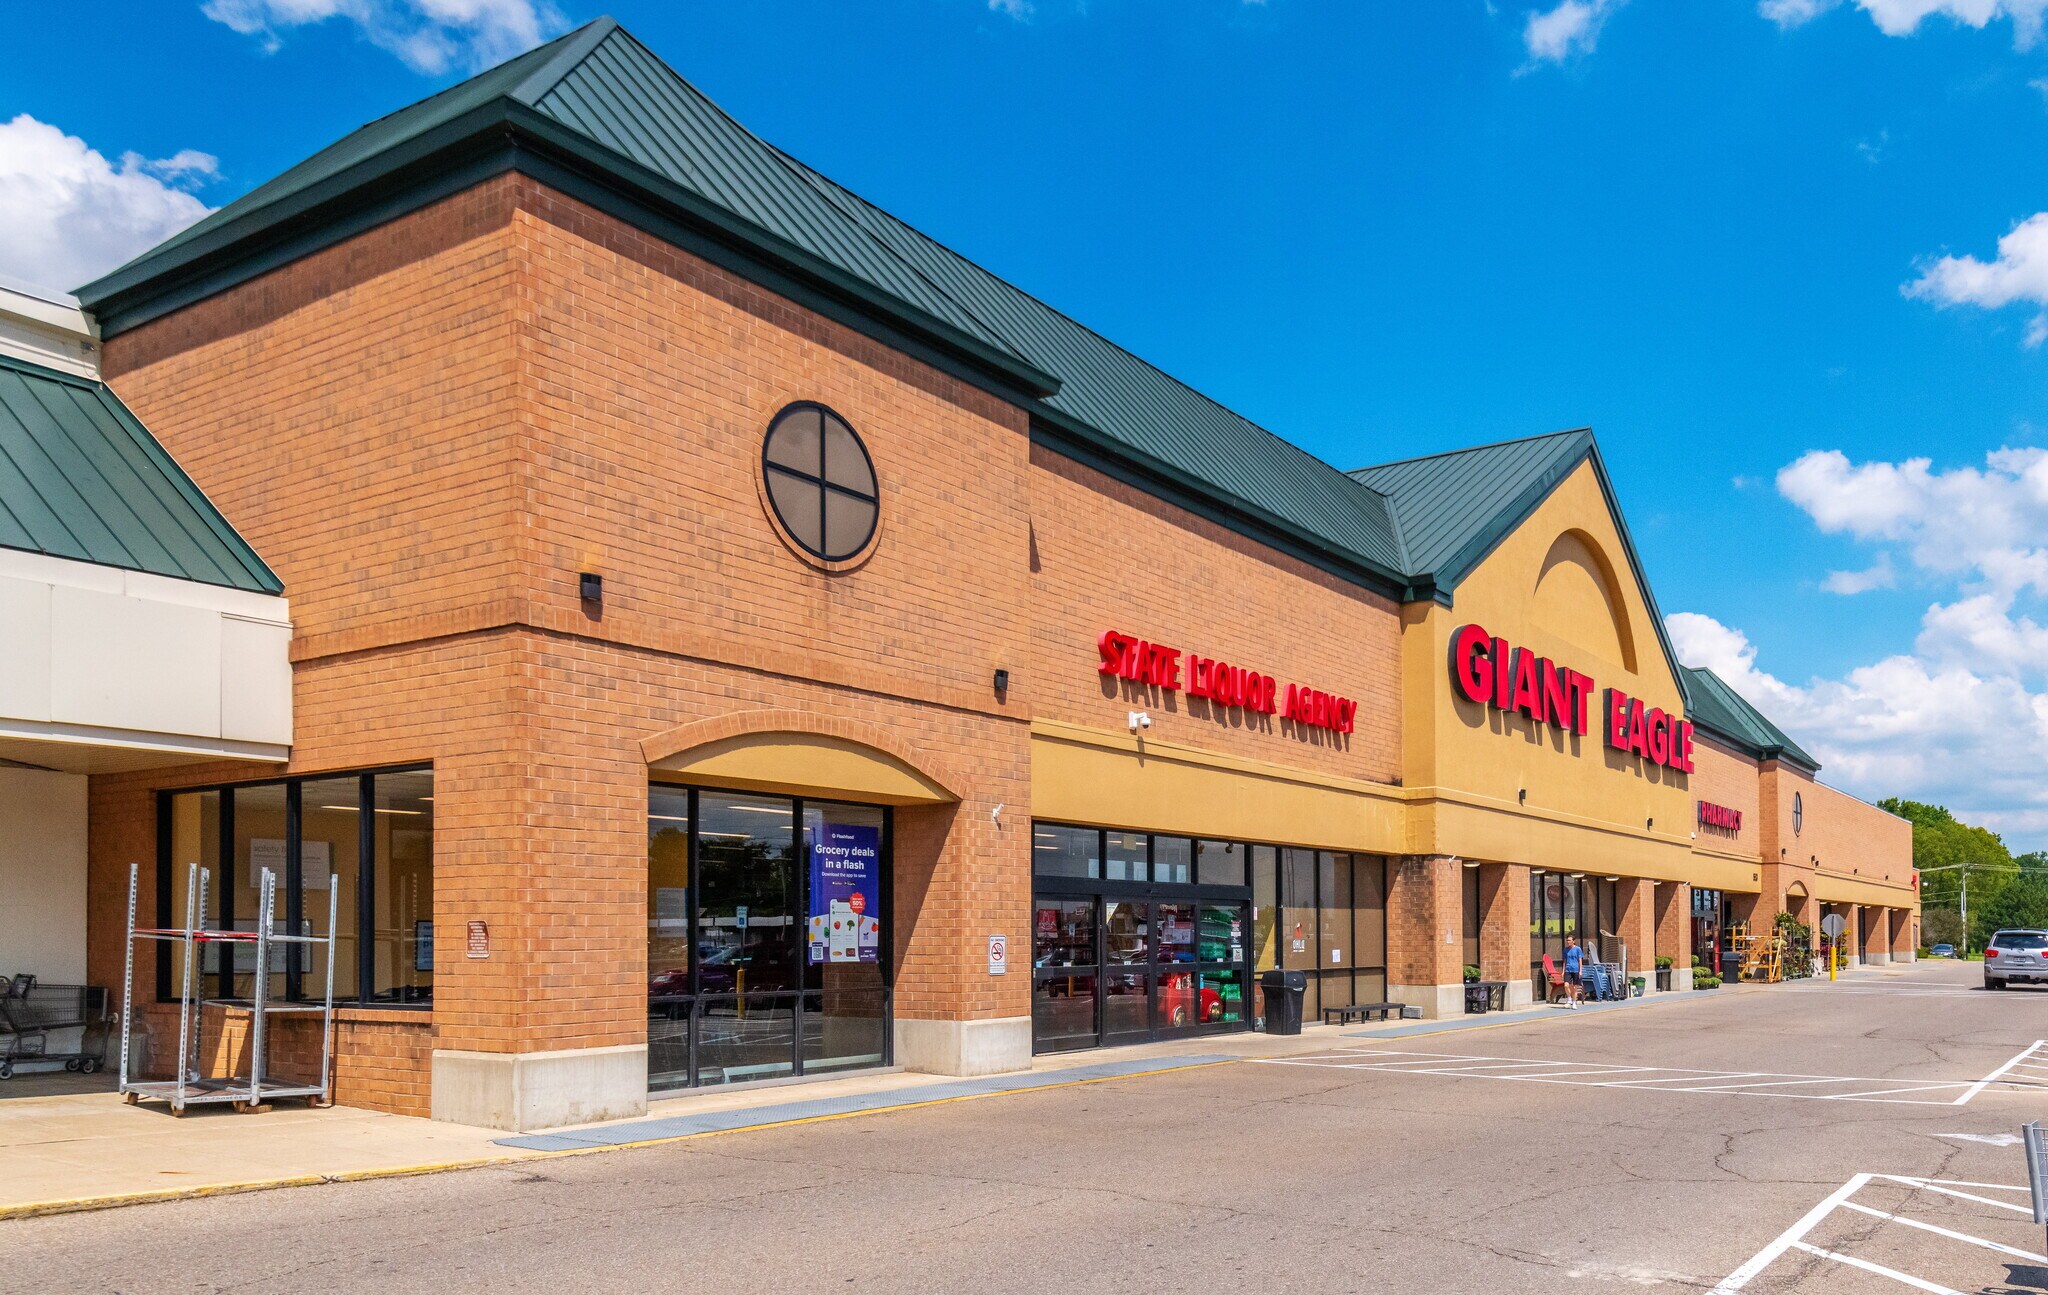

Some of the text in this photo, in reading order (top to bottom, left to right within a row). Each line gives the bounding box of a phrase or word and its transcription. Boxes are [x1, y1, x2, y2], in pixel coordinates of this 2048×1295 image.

[1099, 629, 1358, 735] STATE LIQUOR AGENCY
[1451, 623, 1695, 774] GIANT EAGLE
[1697, 800, 1743, 831] PHARMACY
[815, 843, 875, 858] Grocery deals
[825, 858, 865, 870] in a flash
